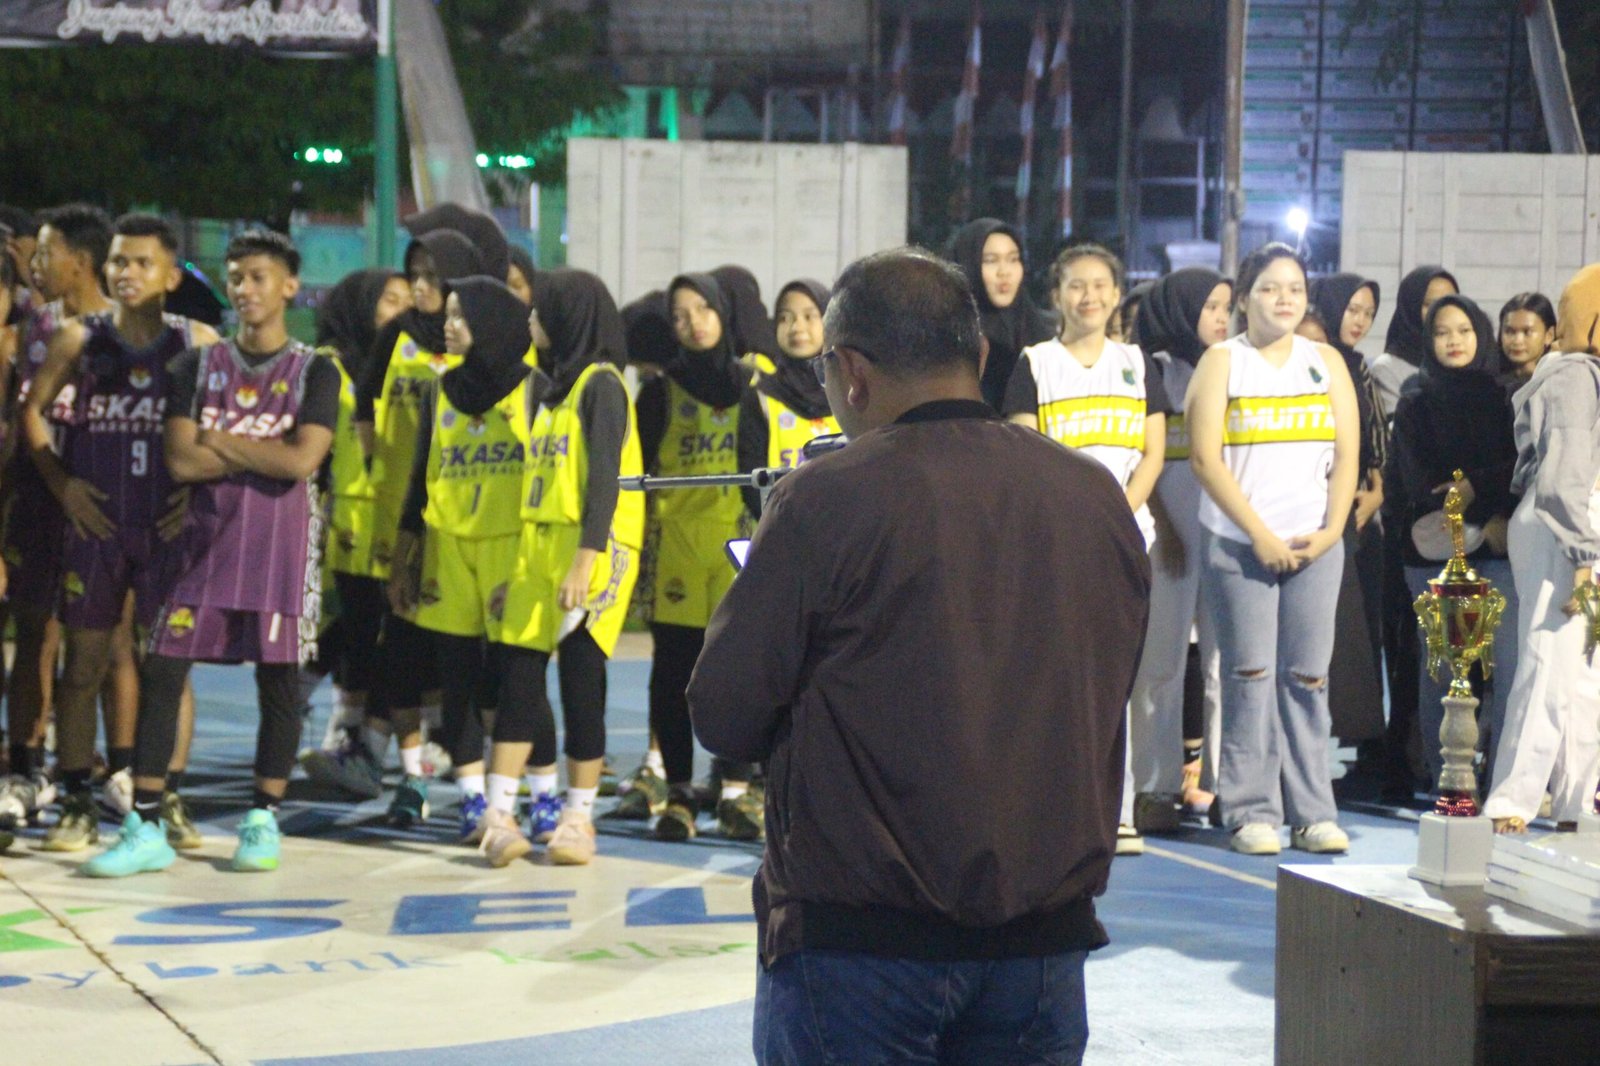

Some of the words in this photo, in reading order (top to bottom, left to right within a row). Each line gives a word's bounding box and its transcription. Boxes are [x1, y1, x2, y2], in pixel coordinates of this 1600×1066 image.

[87, 394, 168, 422] SKAS
[131, 440, 147, 476] 9
[439, 441, 525, 468] SKASA
[678, 432, 735, 456] SKA
[268, 612, 281, 642] 1
[143, 949, 462, 980] bank
